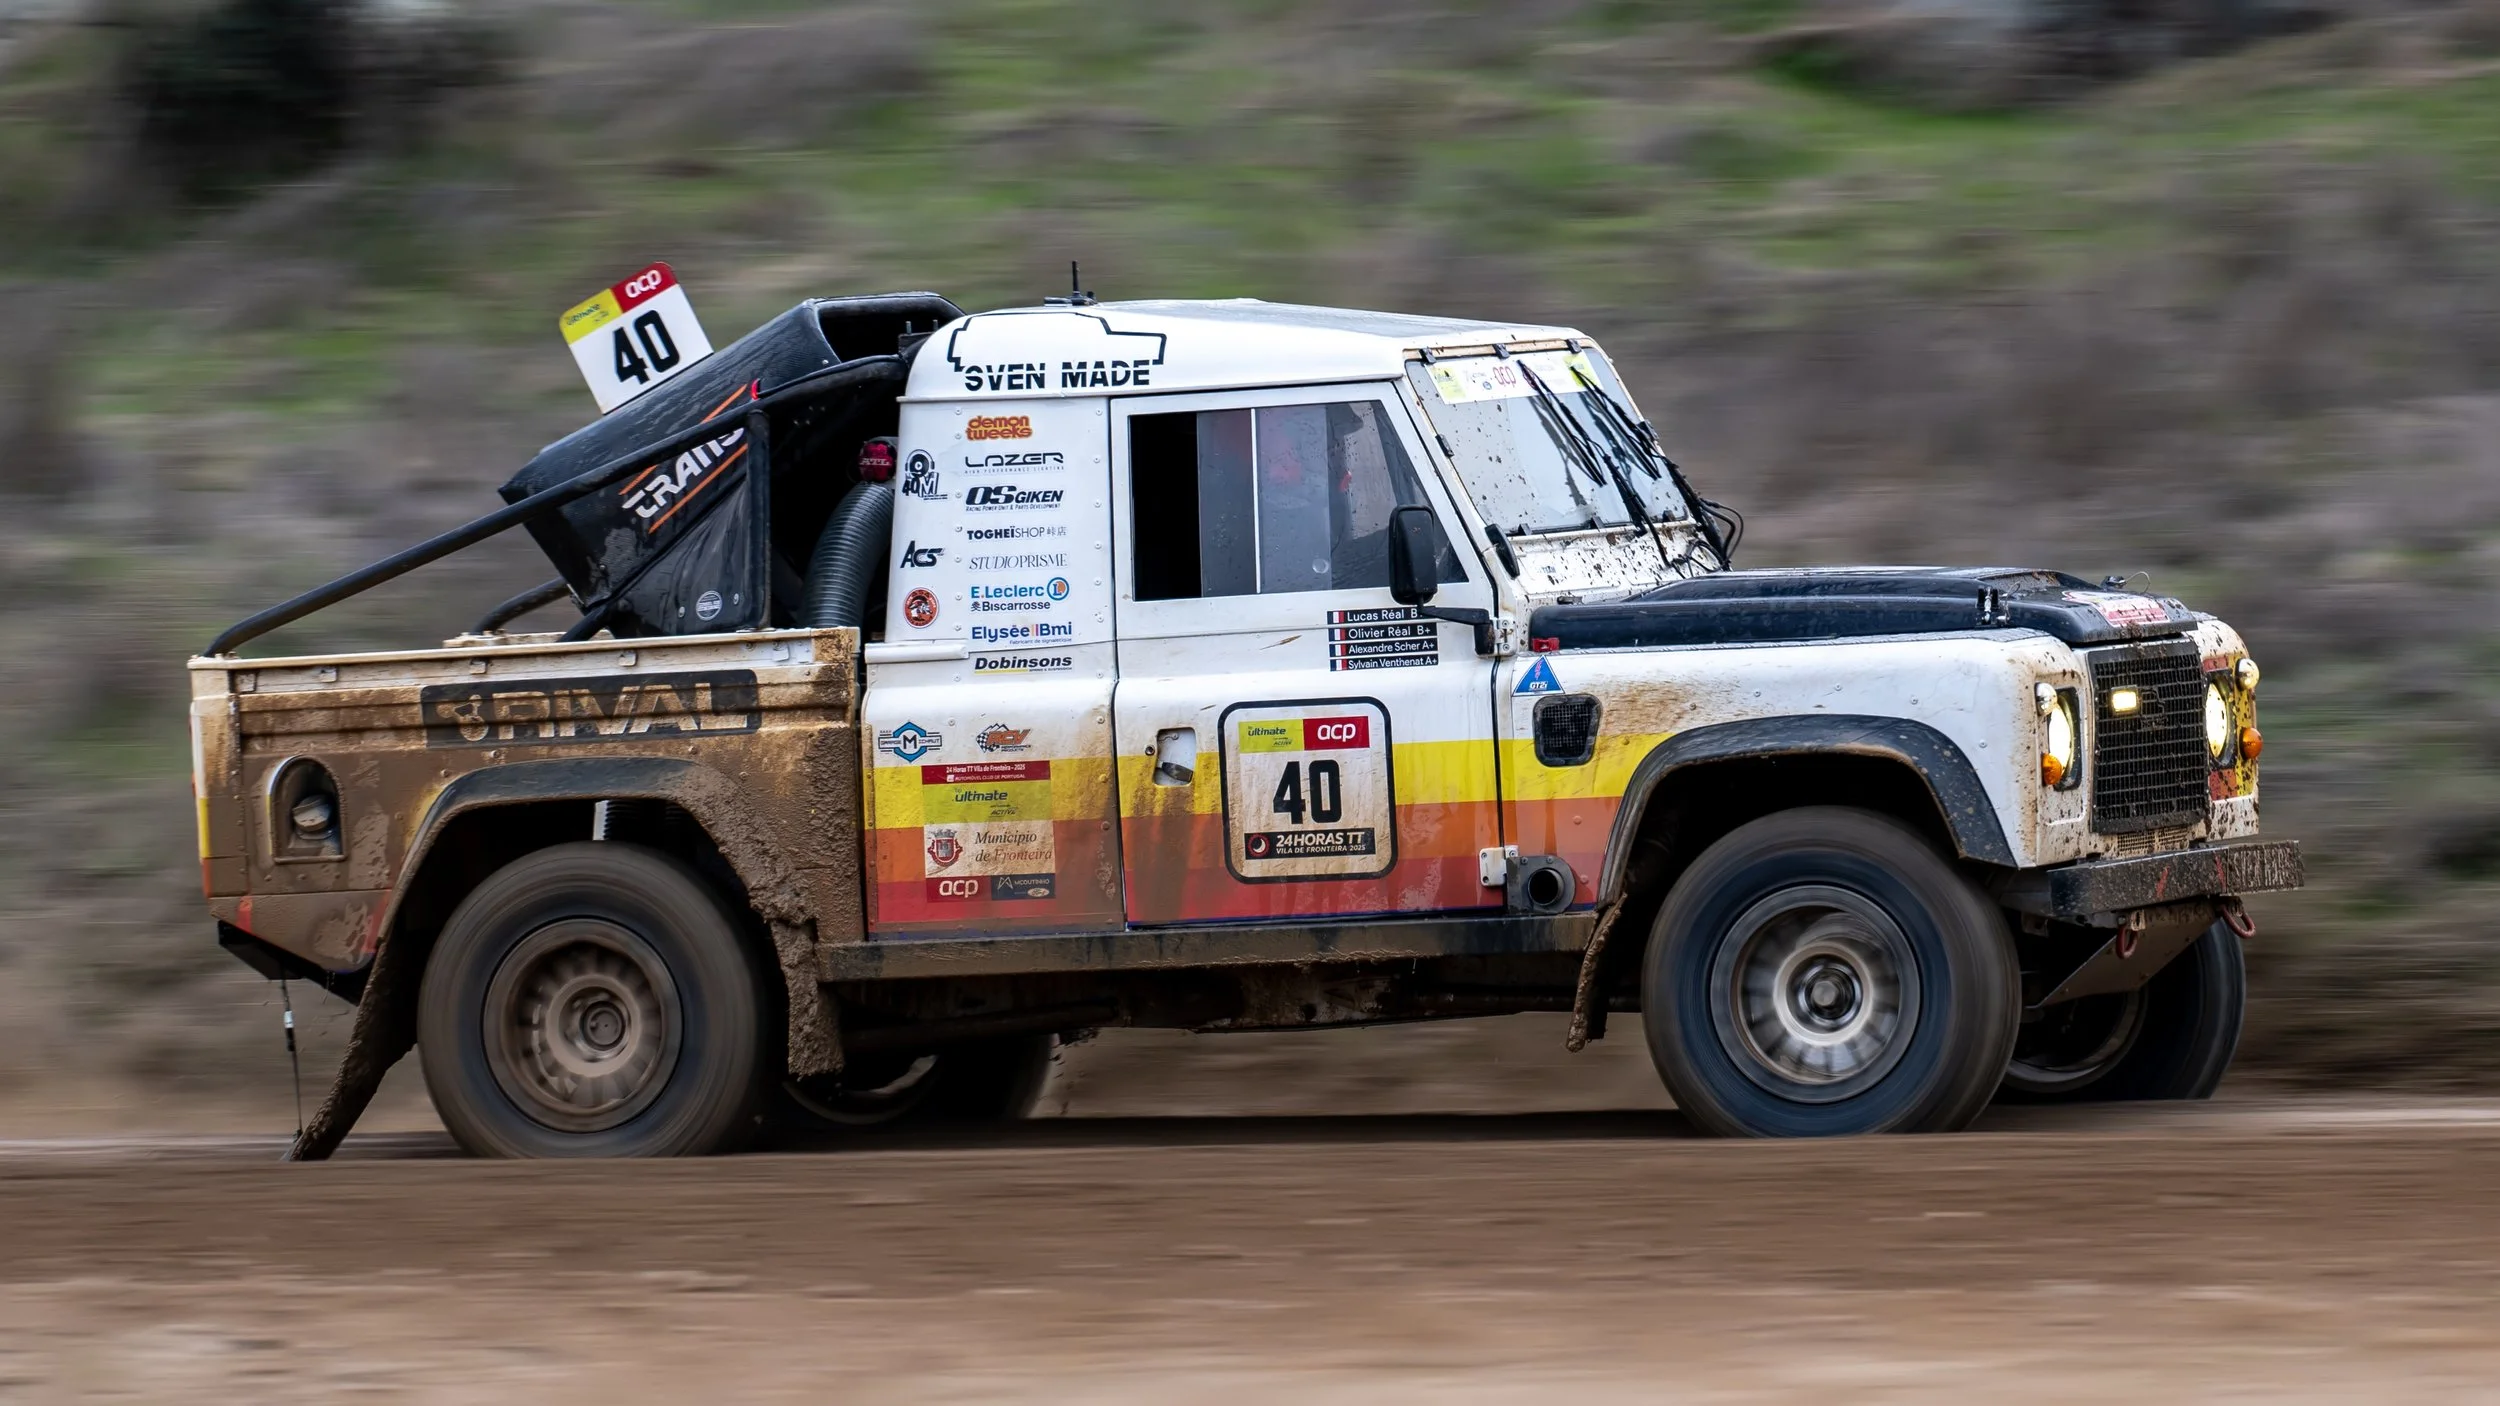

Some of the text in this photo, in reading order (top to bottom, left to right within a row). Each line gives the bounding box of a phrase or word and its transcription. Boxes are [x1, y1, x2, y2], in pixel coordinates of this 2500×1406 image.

[625, 270, 662, 298] acp
[612, 310, 680, 385] 40
[964, 360, 1150, 391] SVEN MADE
[968, 415, 1030, 429] demon
[965, 424, 1033, 441] tweeks
[965, 452, 1064, 467] LAZER
[969, 553, 1068, 570] STUDIOPRISME
[971, 585, 1045, 599] E.Leclerc
[982, 601, 1051, 612] Biscarrosse
[1347, 612, 1379, 622] Lucas
[1381, 609, 1405, 620] Réal
[1348, 624, 1431, 639] Olivier Réal B+
[1348, 640, 1435, 654] Alexandre Scher A+
[975, 656, 1073, 670] Dobinsons
[1348, 656, 1437, 670] Sylvain Venthenat A+
[491, 682, 749, 740] RIVAL
[1248, 727, 1286, 737] ultimate
[1317, 723, 1357, 742] acp
[955, 790, 1008, 802] ultimate
[1273, 759, 1342, 825] 40
[1347, 831, 1365, 844] TT
[975, 848, 1053, 862] de Fronteira
[1306, 845, 1347, 853] FRONTEIRA
[938, 879, 979, 898] acp
